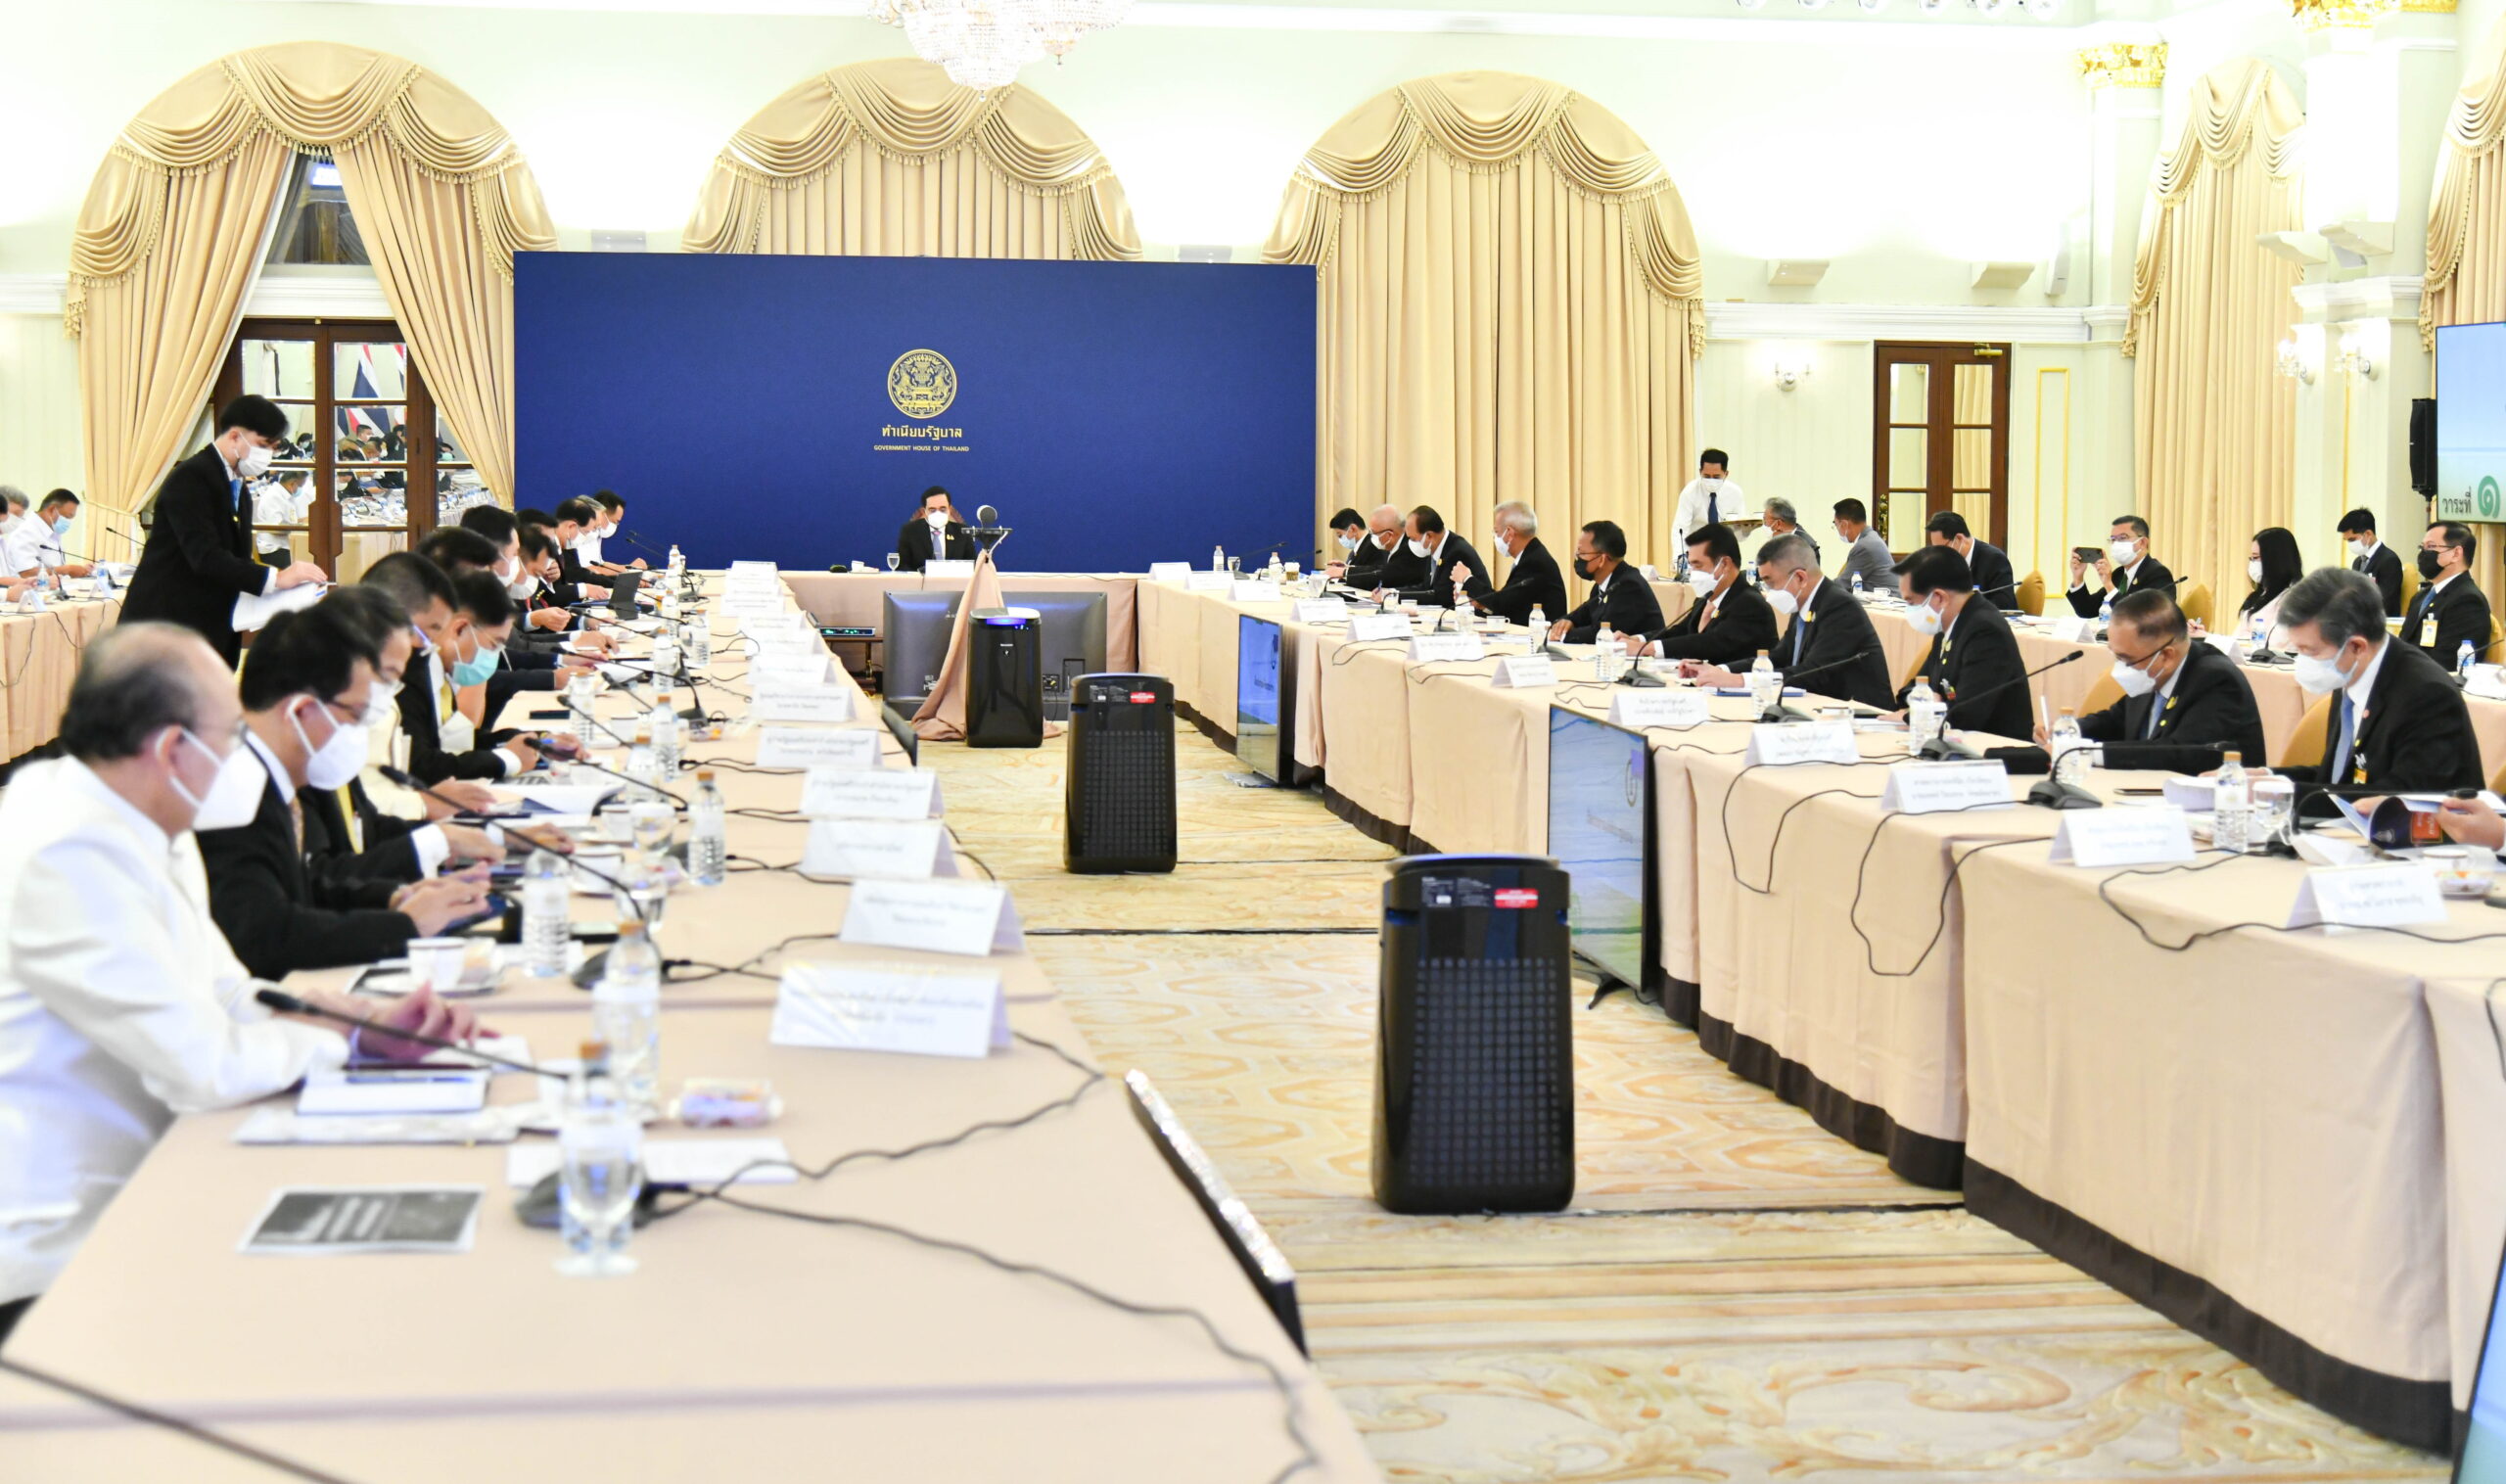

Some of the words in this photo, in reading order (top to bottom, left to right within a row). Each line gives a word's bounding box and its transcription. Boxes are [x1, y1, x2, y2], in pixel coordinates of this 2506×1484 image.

[882, 424, 962, 441] ทำเนียบรัฐบาล
[2442, 486, 2472, 514] วาระที่
[2478, 475, 2501, 519] ๑
